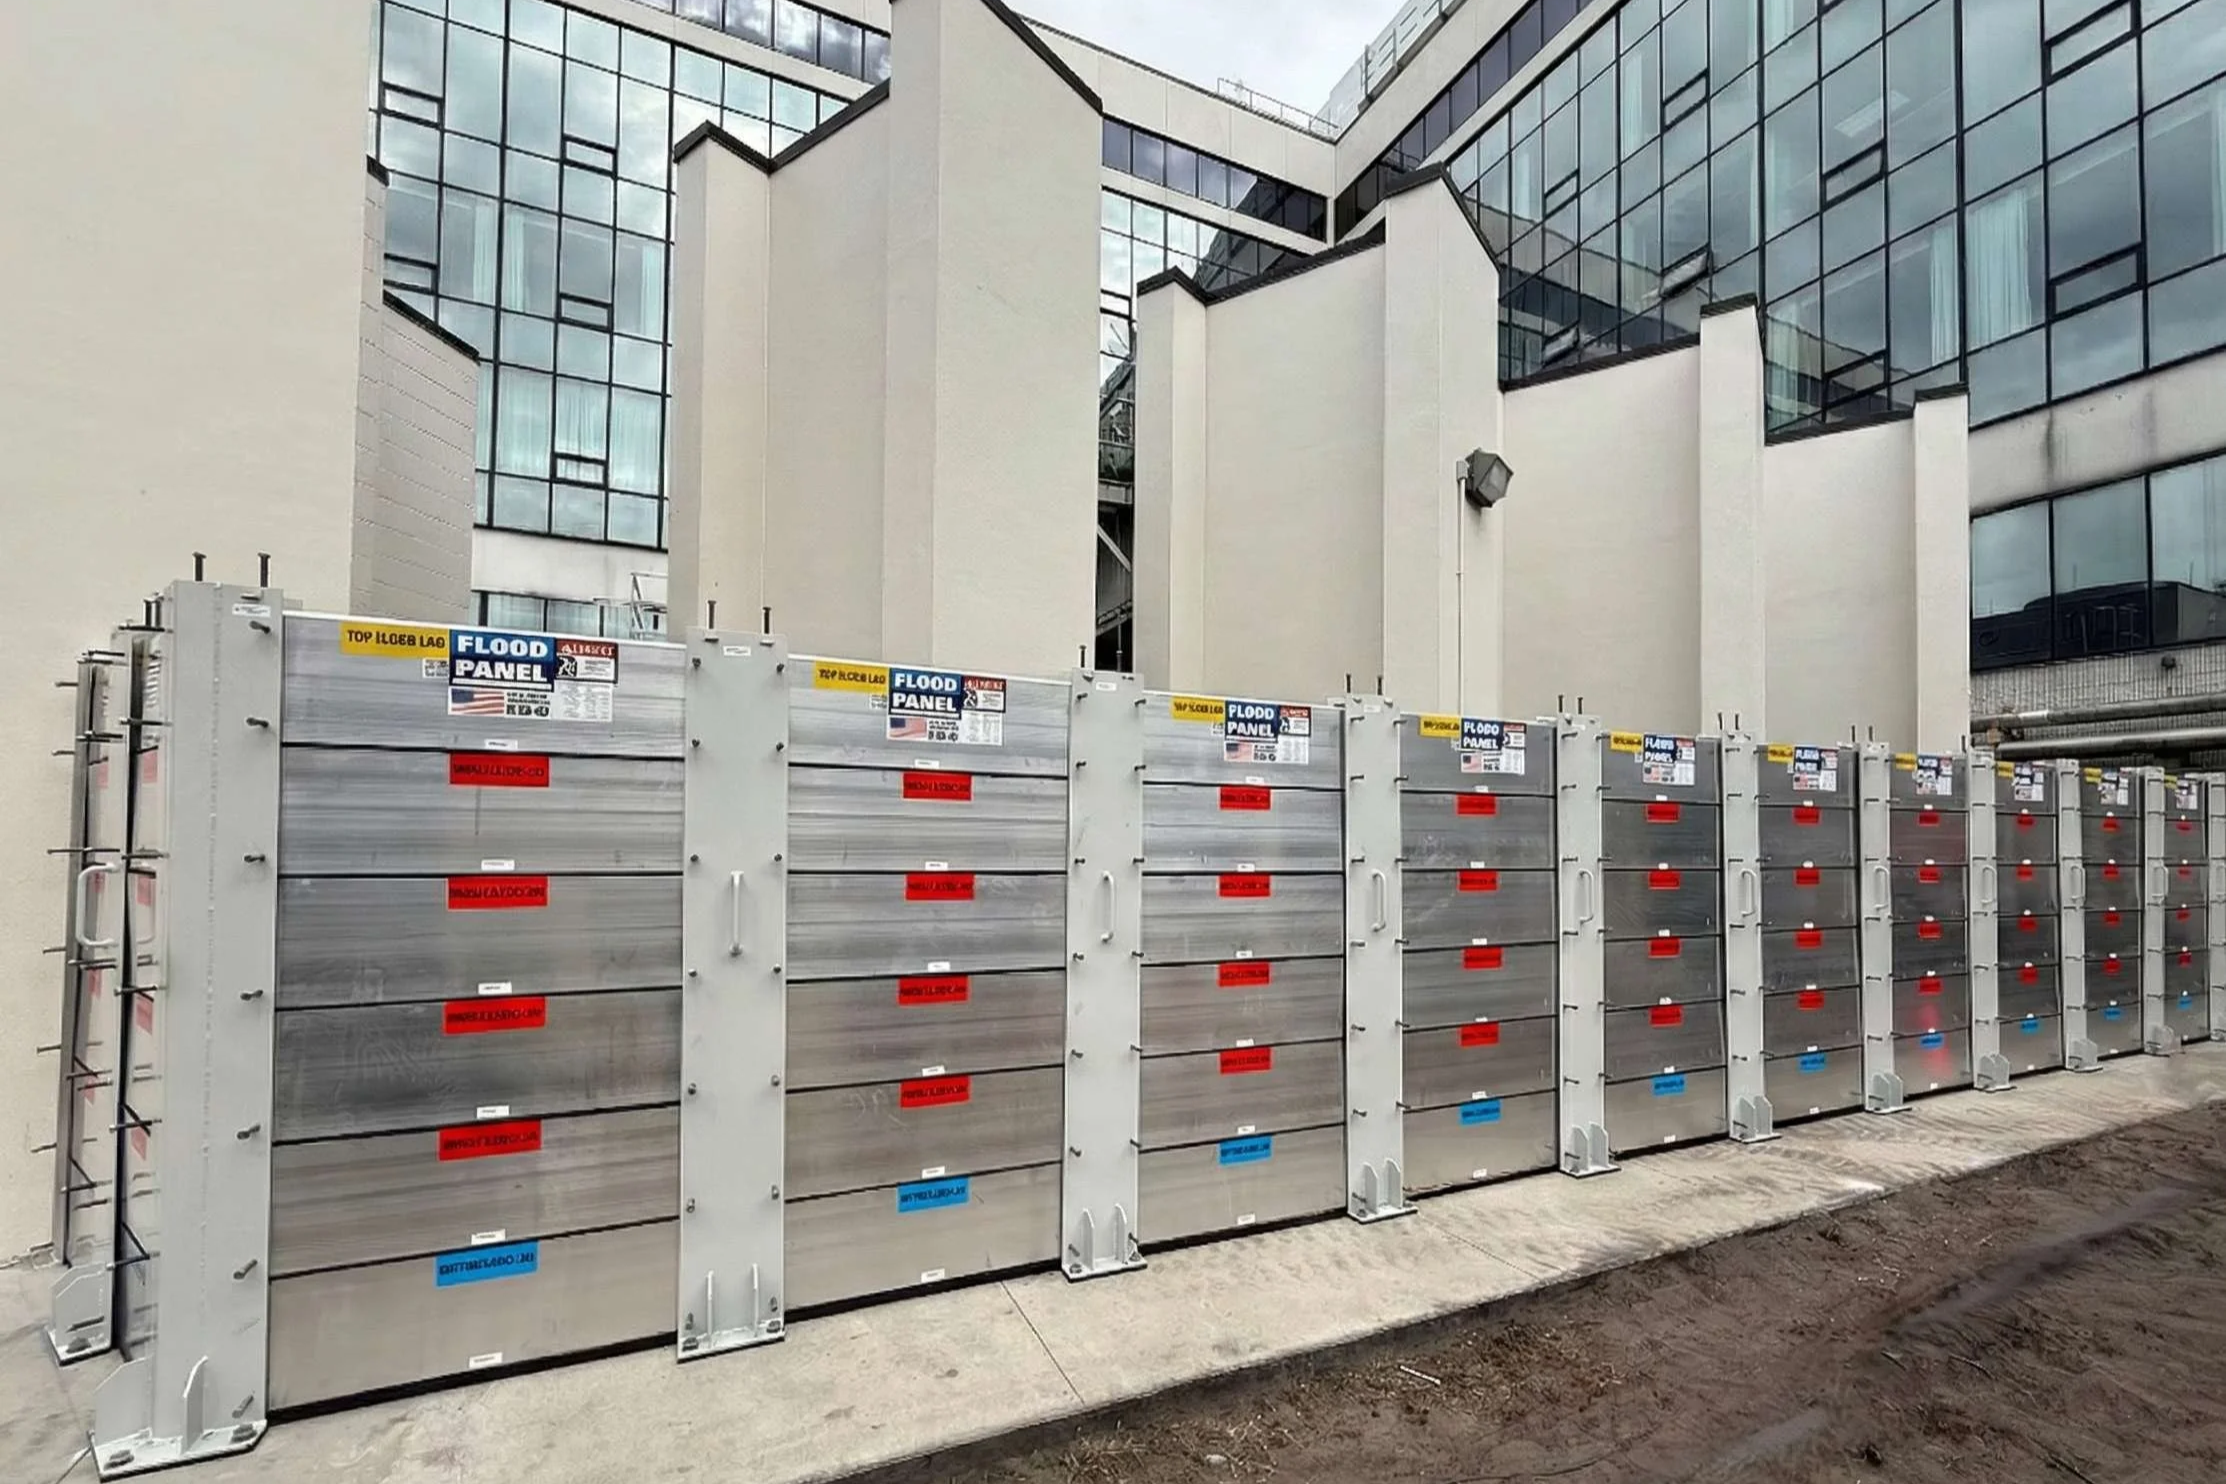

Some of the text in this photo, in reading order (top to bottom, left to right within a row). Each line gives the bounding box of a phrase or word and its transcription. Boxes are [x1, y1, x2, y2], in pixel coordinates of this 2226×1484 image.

[348, 630, 372, 643] TOP
[457, 635, 548, 658] FLOOD
[455, 659, 547, 682] PANEL
[895, 673, 957, 691] FLOOD
[892, 692, 956, 712] PANEL
